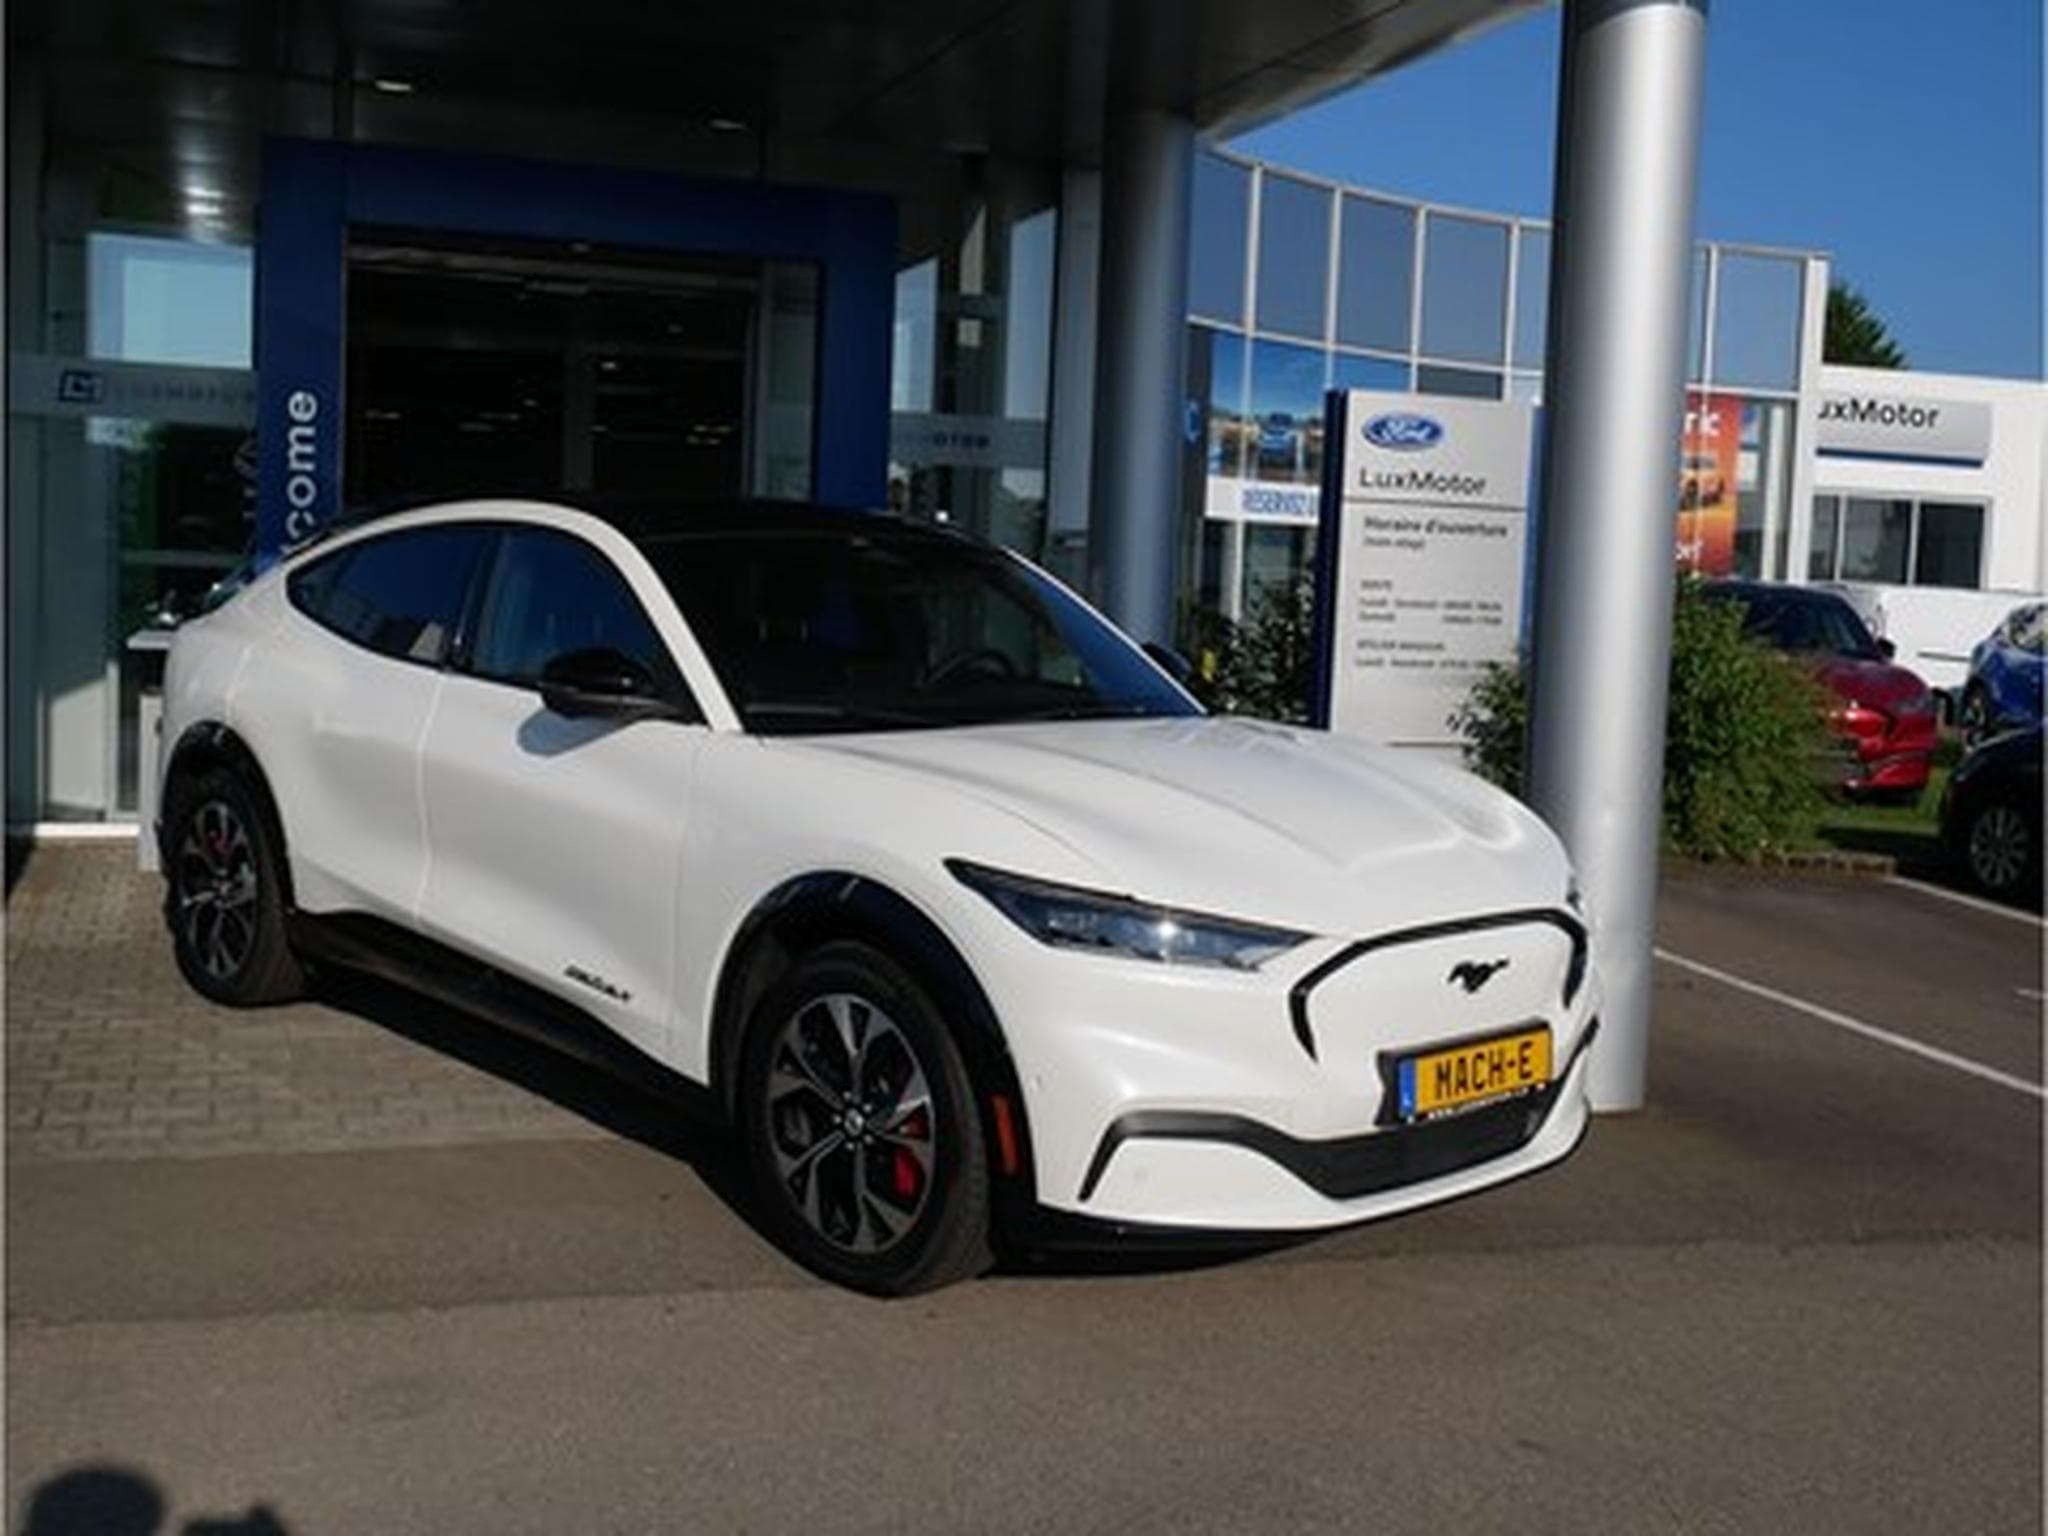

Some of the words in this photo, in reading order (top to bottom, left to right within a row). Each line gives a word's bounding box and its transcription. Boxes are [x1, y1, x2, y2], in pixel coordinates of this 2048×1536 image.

[284, 391, 318, 552] come
[1359, 467, 1487, 496] LuxMotor
[1435, 1041, 1533, 1099] MACH-E
